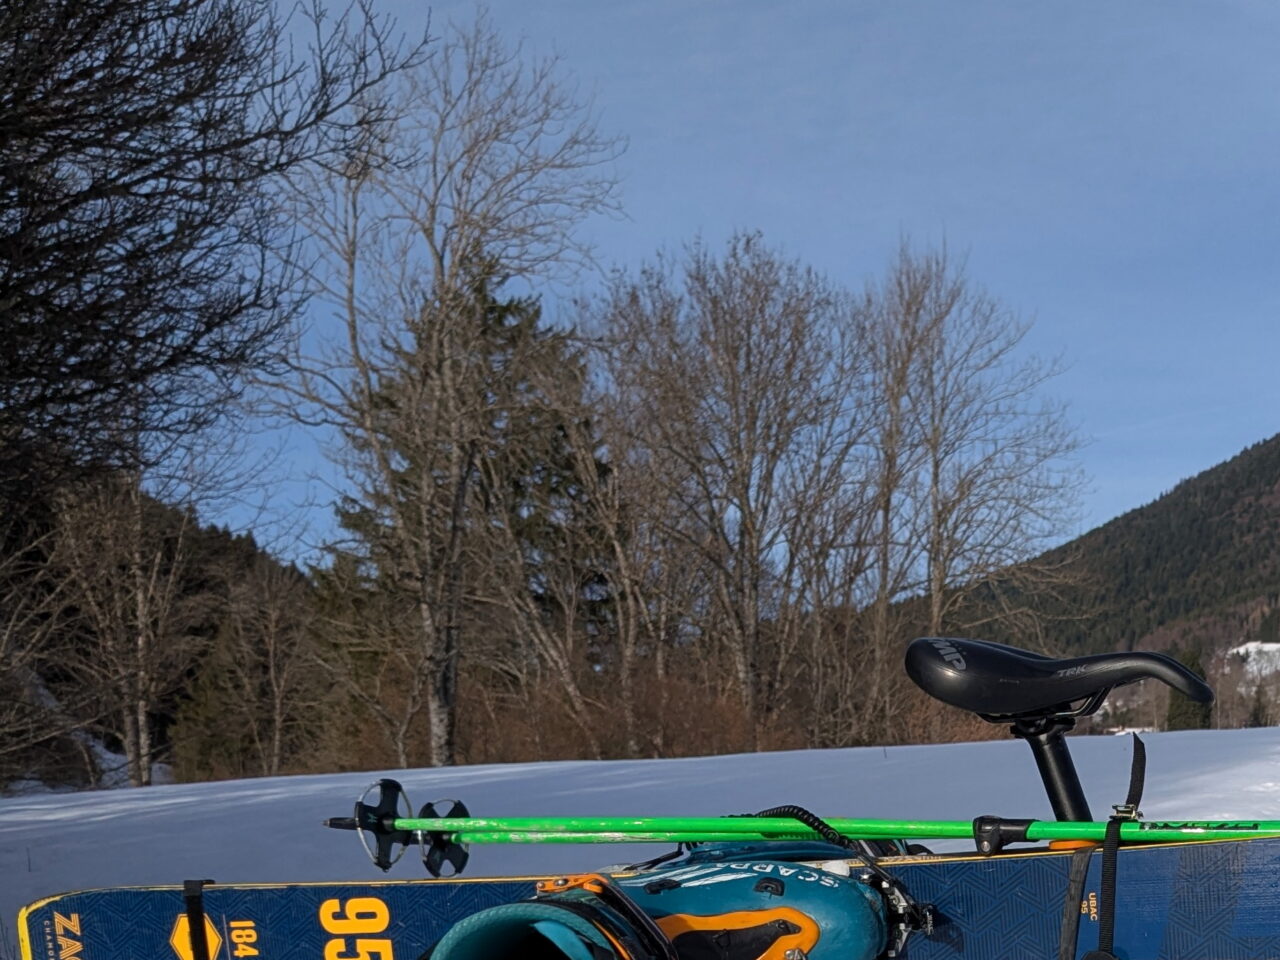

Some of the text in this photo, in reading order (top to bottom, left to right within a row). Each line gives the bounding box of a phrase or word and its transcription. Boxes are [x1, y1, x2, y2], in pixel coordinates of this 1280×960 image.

[1056, 664, 1088, 678] TRK
[1088, 892, 1099, 922] UBAC
[228, 919, 260, 958] 184
